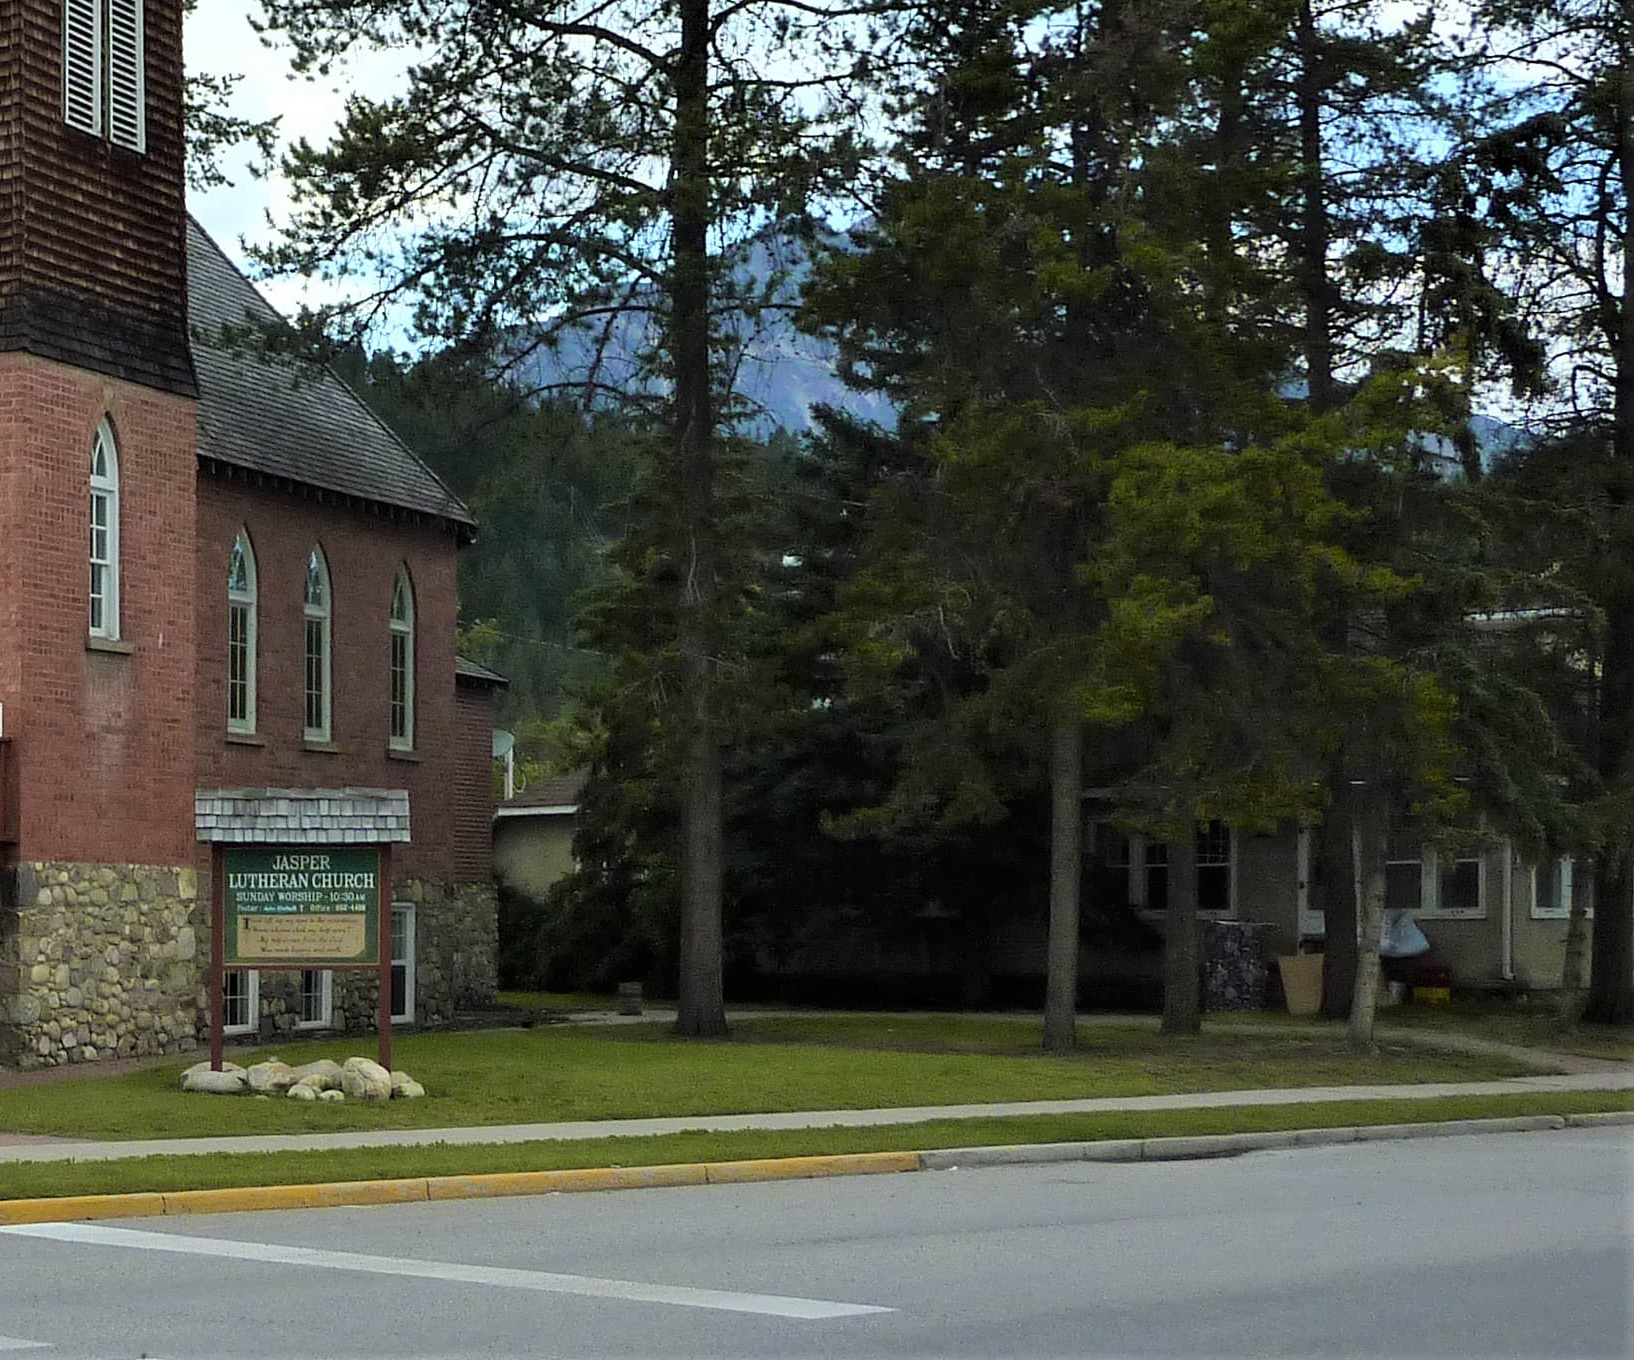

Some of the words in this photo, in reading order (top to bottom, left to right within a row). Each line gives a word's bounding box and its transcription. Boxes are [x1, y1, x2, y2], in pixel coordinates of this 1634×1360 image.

[272, 854, 331, 871] JASPER
[228, 873, 309, 889] LUTHERAN
[311, 872, 375, 889] CHURCH
[236, 891, 276, 902] SUNDAY
[276, 891, 323, 902] WORSHIP
